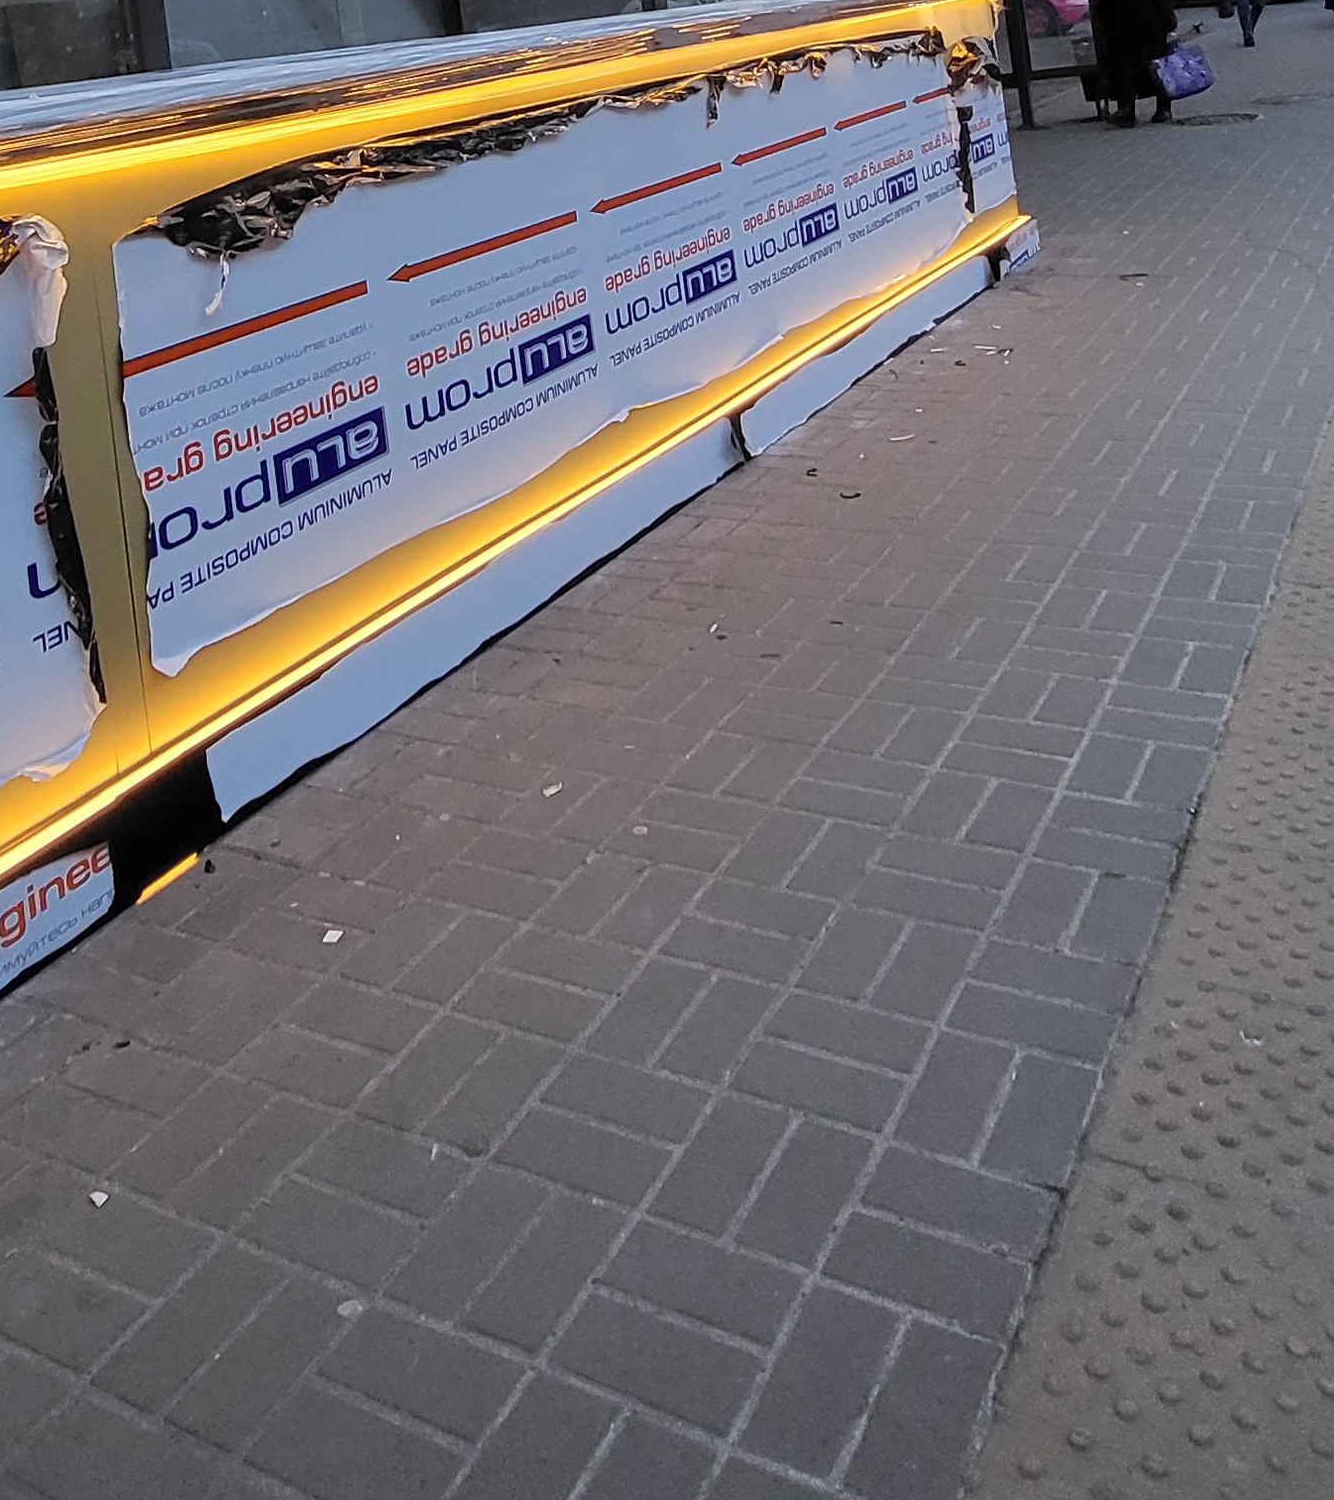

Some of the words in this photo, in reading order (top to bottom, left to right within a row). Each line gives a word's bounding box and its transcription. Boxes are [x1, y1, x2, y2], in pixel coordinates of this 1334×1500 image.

[843, 165, 868, 191] grade
[869, 150, 914, 178] engineering
[778, 183, 835, 219] engineering
[743, 205, 776, 234] grade
[654, 227, 731, 271] engineering
[809, 239, 843, 264] ALUMINIUM
[605, 255, 651, 294] grade
[748, 274, 771, 296] PANEL
[772, 254, 809, 283] COMPOSITE
[478, 287, 587, 348] engineering
[694, 292, 741, 325] ALUMINIUM
[643, 315, 695, 351] COMPOSITE
[406, 329, 473, 379] grade
[609, 341, 642, 367] PANEL
[197, 374, 234, 396] после
[240, 375, 311, 410] направления
[536, 363, 598, 407] ALUMINIUM
[139, 389, 195, 418] монтажа
[190, 404, 238, 430] стрелок
[214, 376, 379, 463] engineering
[165, 424, 188, 443] при
[460, 396, 534, 447] COMPOSITE
[132, 435, 164, 455] монт
[410, 435, 458, 471] PANEL
[143, 443, 204, 493] gra
[297, 468, 393, 531] ALUMINIUM
[180, 520, 294, 594] COMPOSITE
